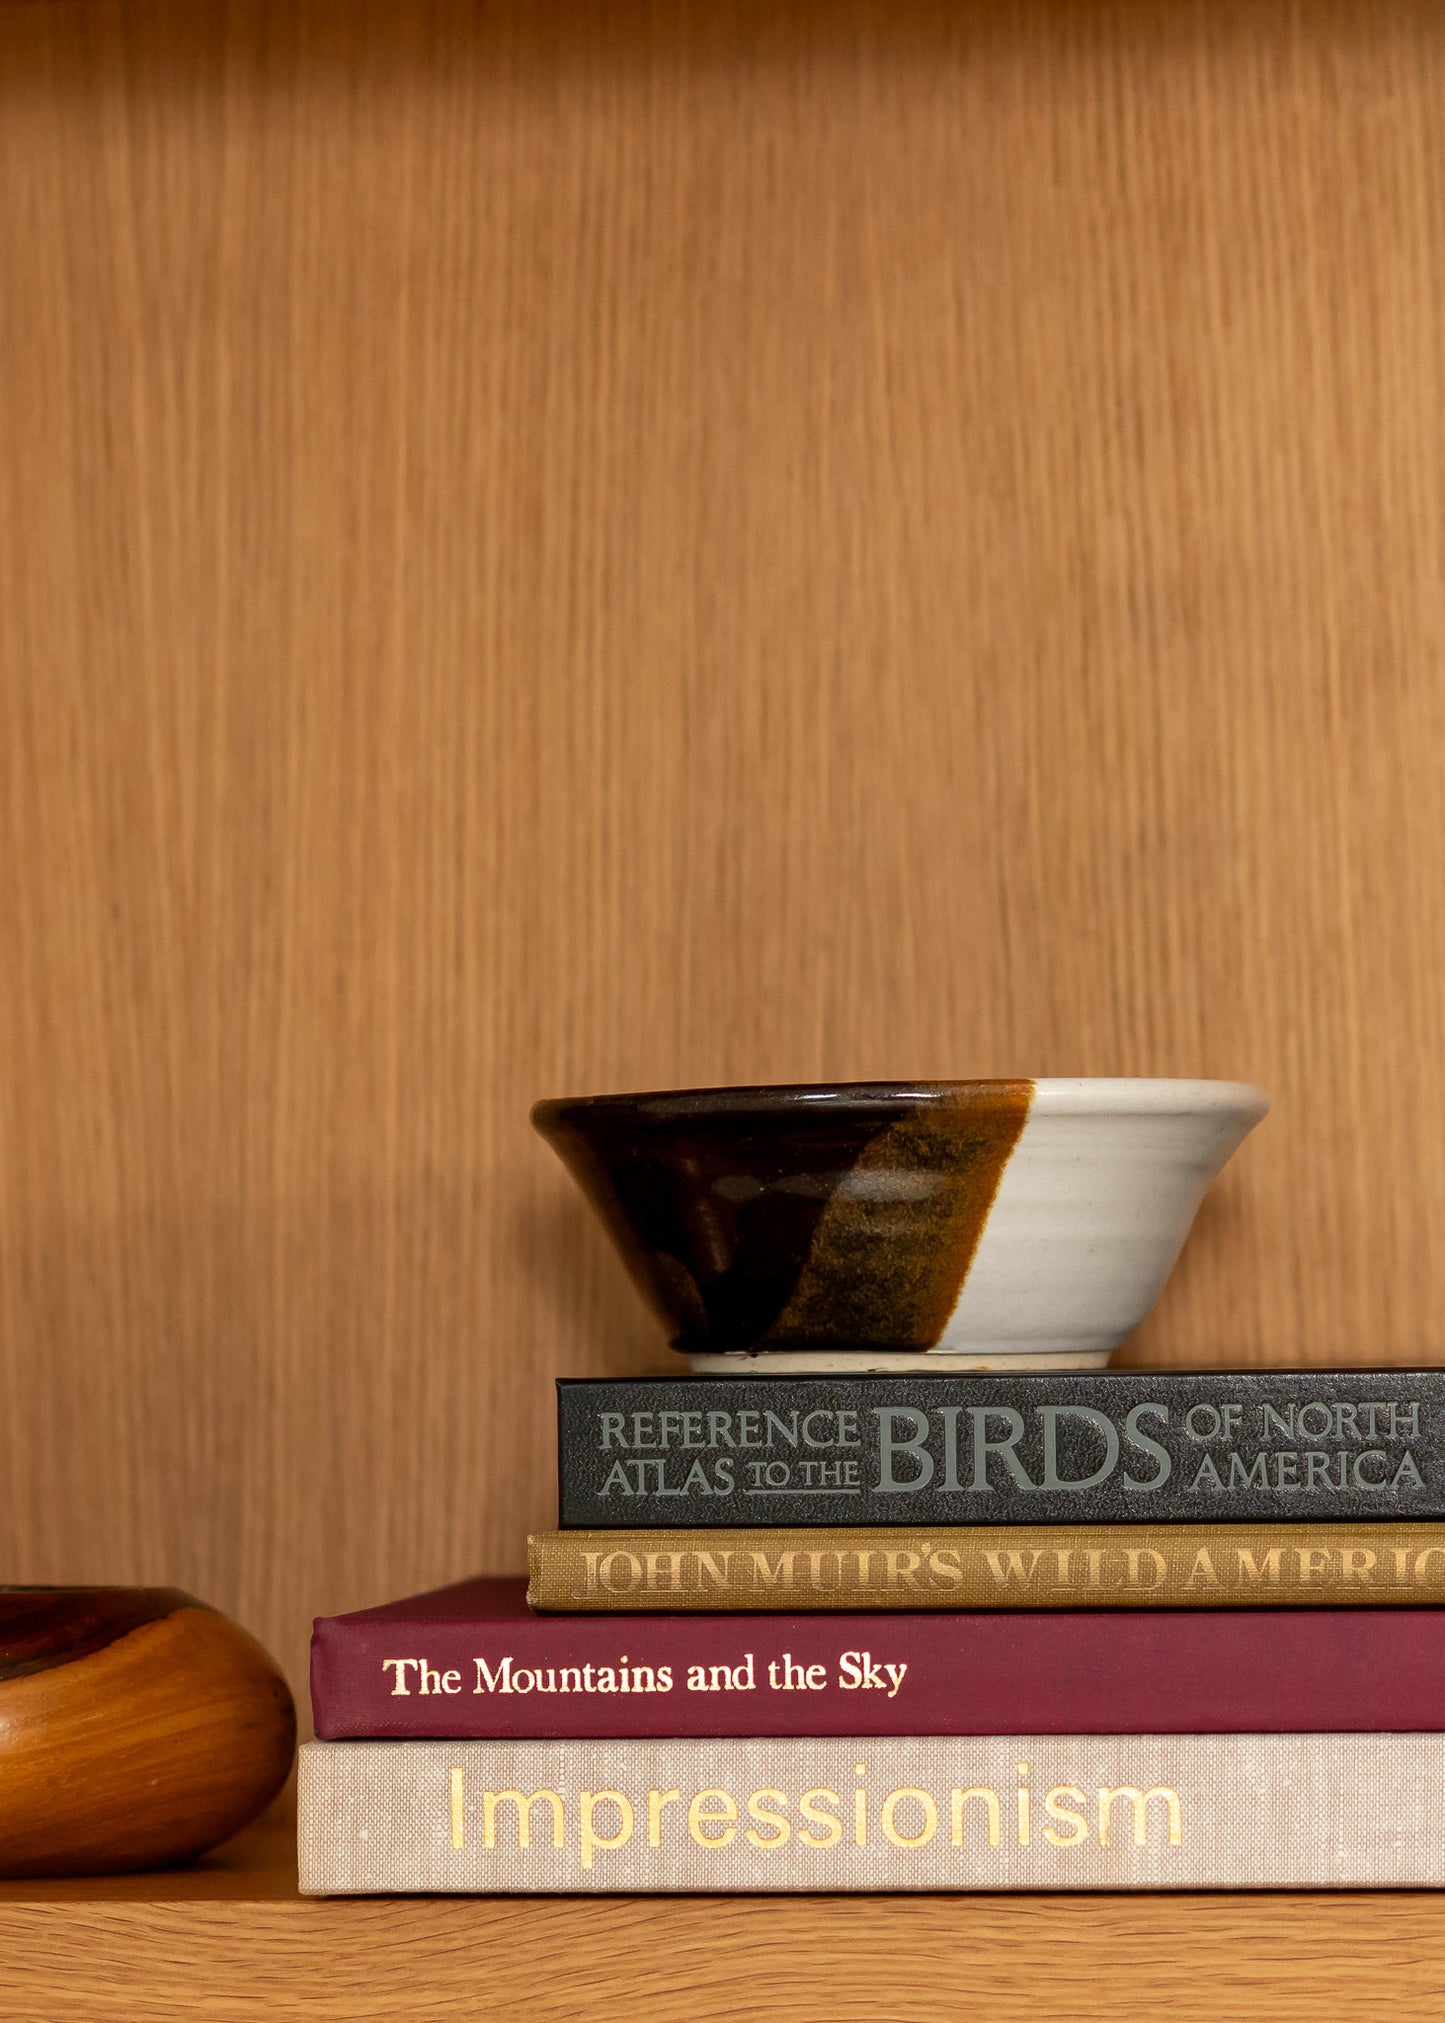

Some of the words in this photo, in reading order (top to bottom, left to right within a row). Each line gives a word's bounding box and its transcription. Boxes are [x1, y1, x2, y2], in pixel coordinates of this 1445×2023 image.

[600, 1410, 861, 1450] REFERENCE
[1186, 1404, 1243, 1440] OF
[1262, 1401, 1422, 1440] NORTH
[872, 1402, 1173, 1494] BIRDS
[1187, 1449, 1427, 1491] AMERICA
[598, 1457, 735, 1496] ATLAS
[747, 1462, 789, 1487] TO
[799, 1460, 861, 1486] THE
[571, 1550, 733, 1601] JOHN
[980, 1547, 1167, 1592] WILD
[382, 1658, 461, 1696] The
[472, 1655, 674, 1694] Mountains
[686, 1653, 756, 1691] and
[768, 1653, 827, 1690] the
[839, 1651, 908, 1698] Sky
[450, 1762, 1183, 1870] Impressionism
